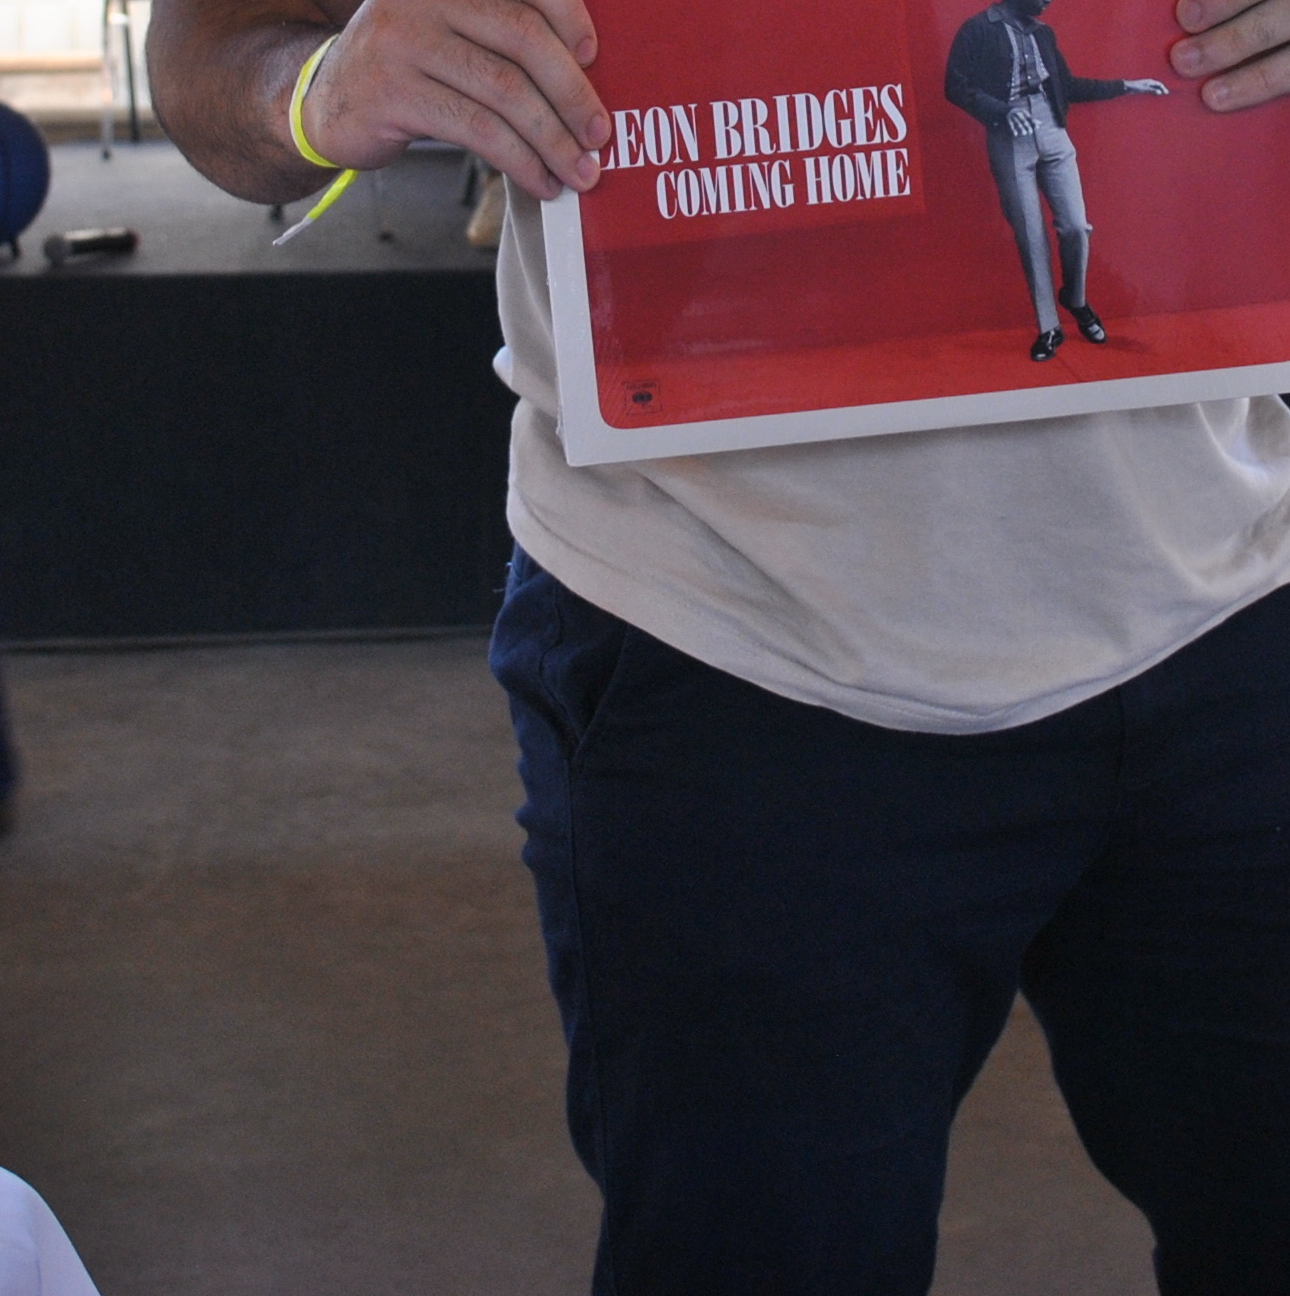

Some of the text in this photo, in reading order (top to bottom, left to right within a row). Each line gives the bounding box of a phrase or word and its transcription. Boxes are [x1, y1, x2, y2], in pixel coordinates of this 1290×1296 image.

[709, 83, 909, 161] BRIDGES
[656, 147, 911, 220] COMING HOME
